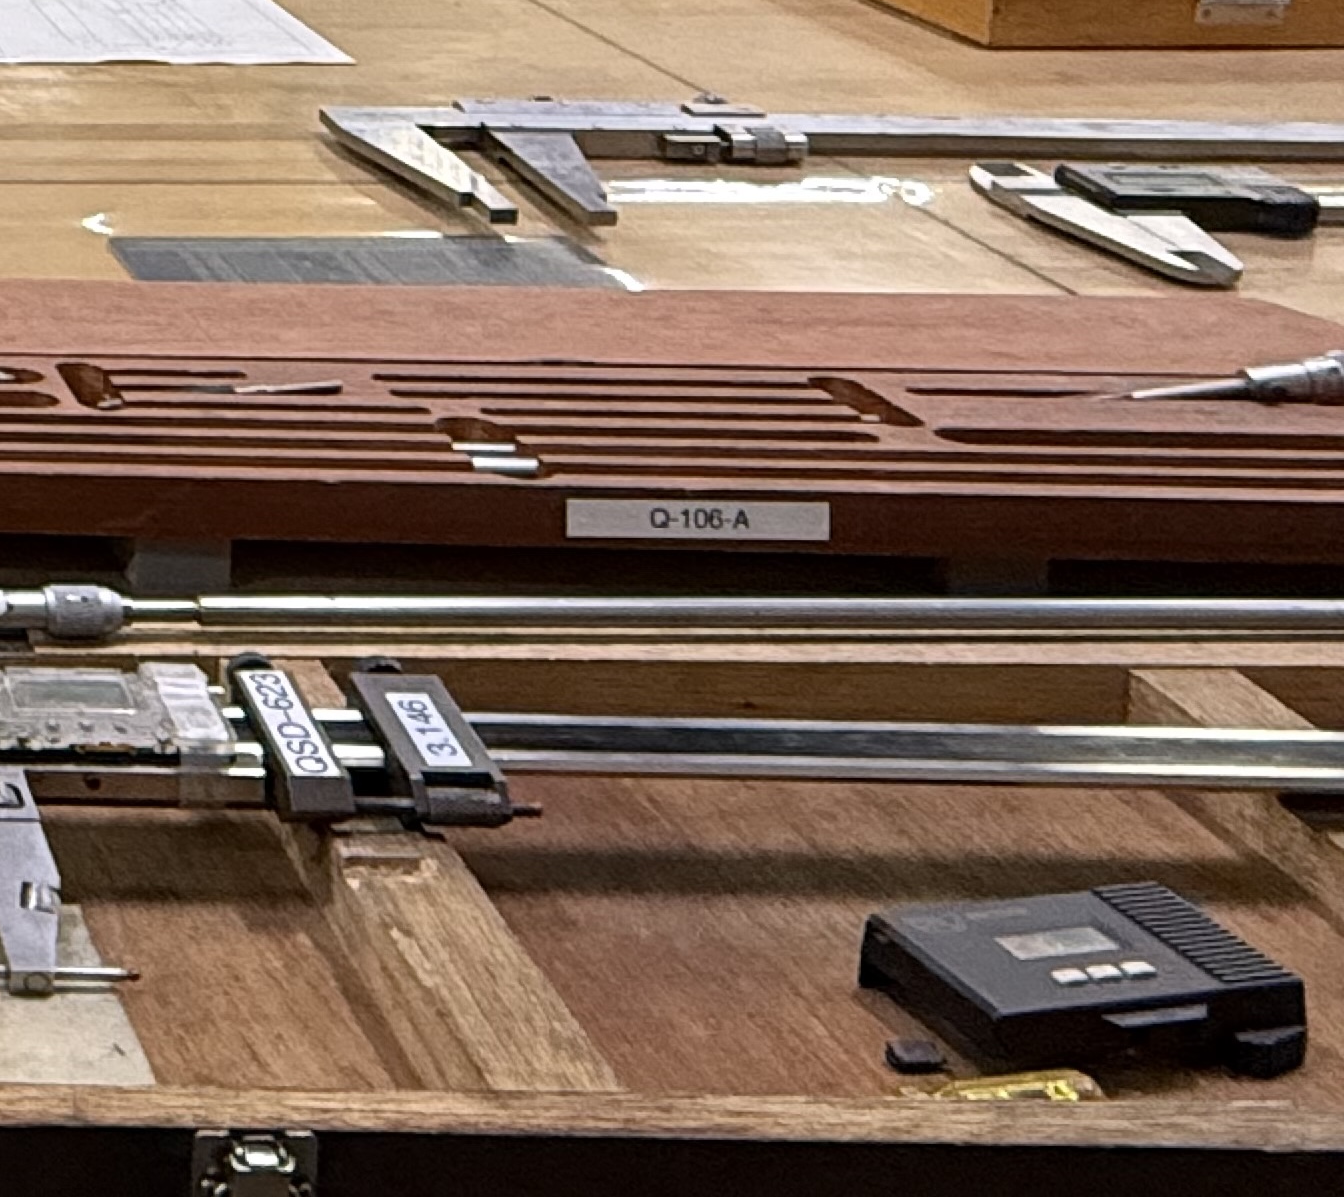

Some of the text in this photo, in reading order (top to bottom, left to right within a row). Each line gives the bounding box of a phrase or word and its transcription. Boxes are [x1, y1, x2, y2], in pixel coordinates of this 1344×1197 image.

[650, 508, 750, 530] Q-106-A
[249, 672, 329, 775] QSD-623
[399, 699, 459, 758] 3.146
